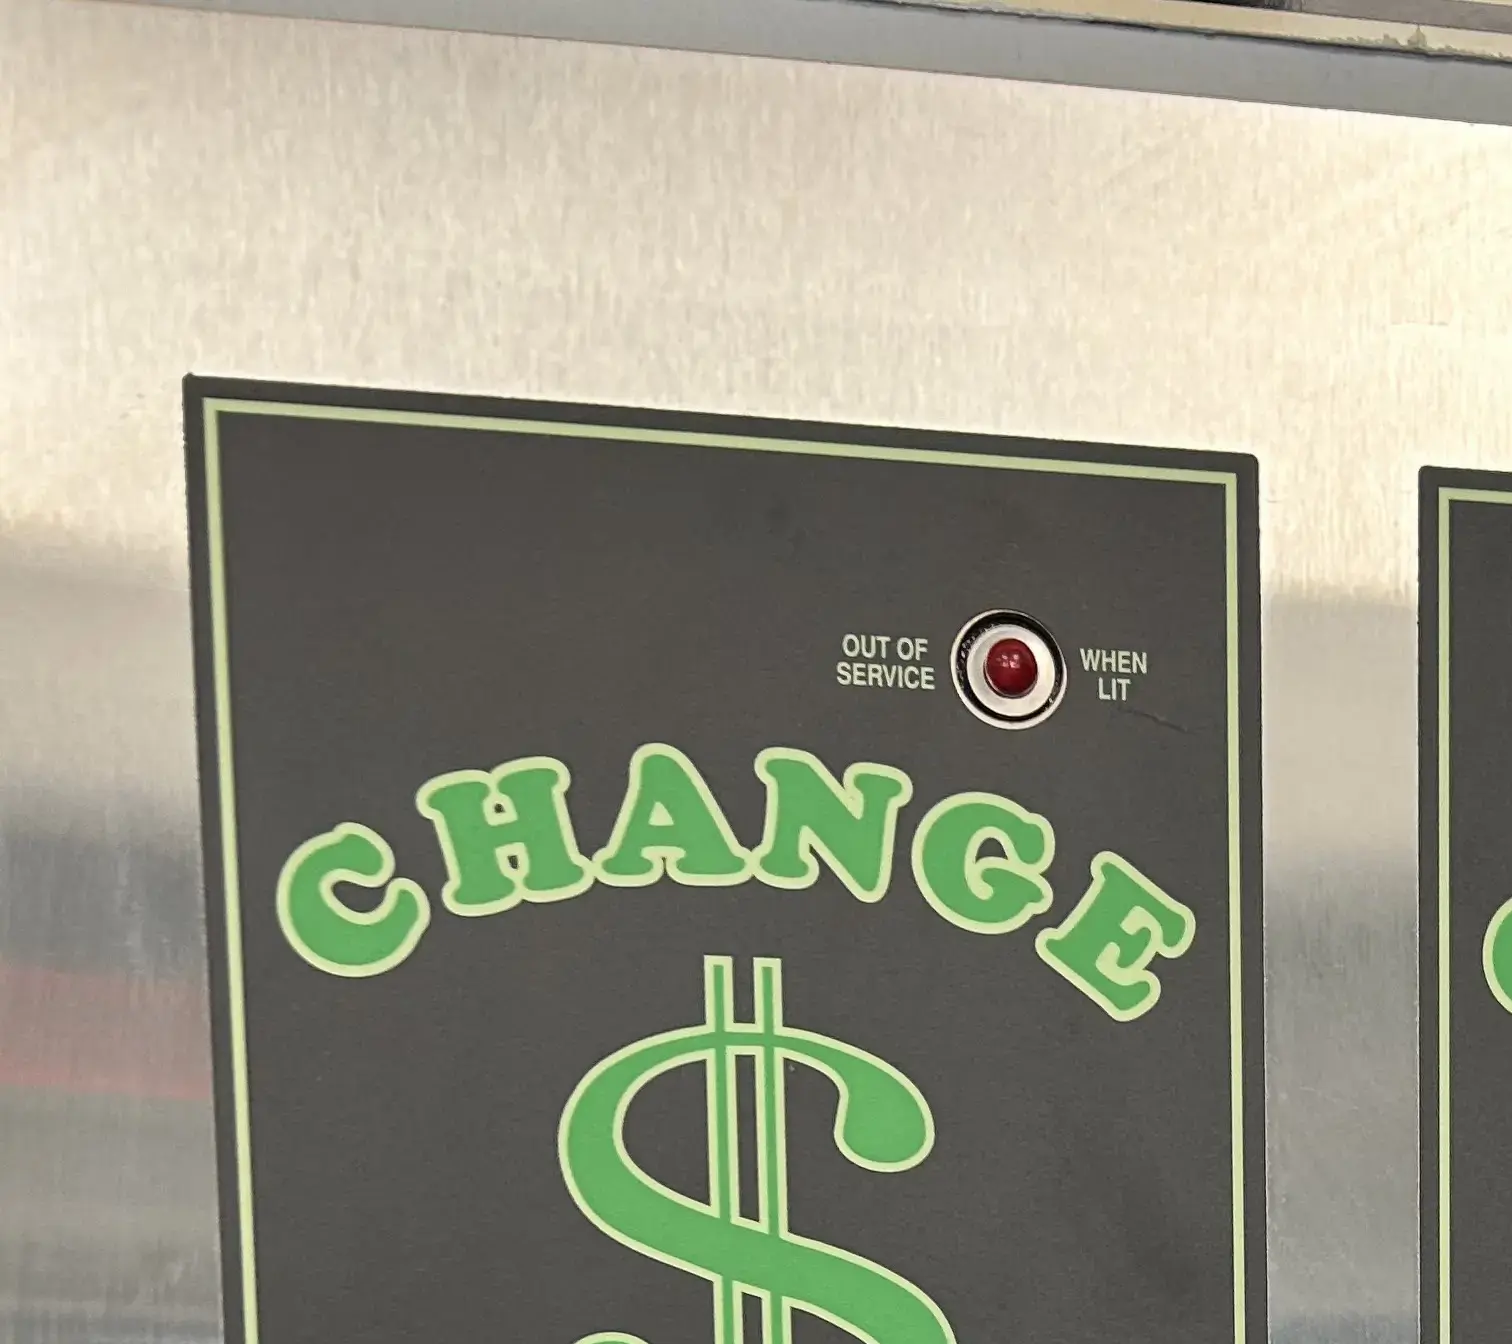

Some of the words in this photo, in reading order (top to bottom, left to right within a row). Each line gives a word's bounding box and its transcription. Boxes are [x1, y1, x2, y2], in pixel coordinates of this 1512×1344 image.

[841, 632, 891, 660] OUT
[896, 636, 928, 661] OF
[836, 661, 935, 690] SERVICE
[1079, 648, 1148, 675] WHEN
[1097, 677, 1131, 701] LIT
[276, 742, 1196, 1023] CHANGE
